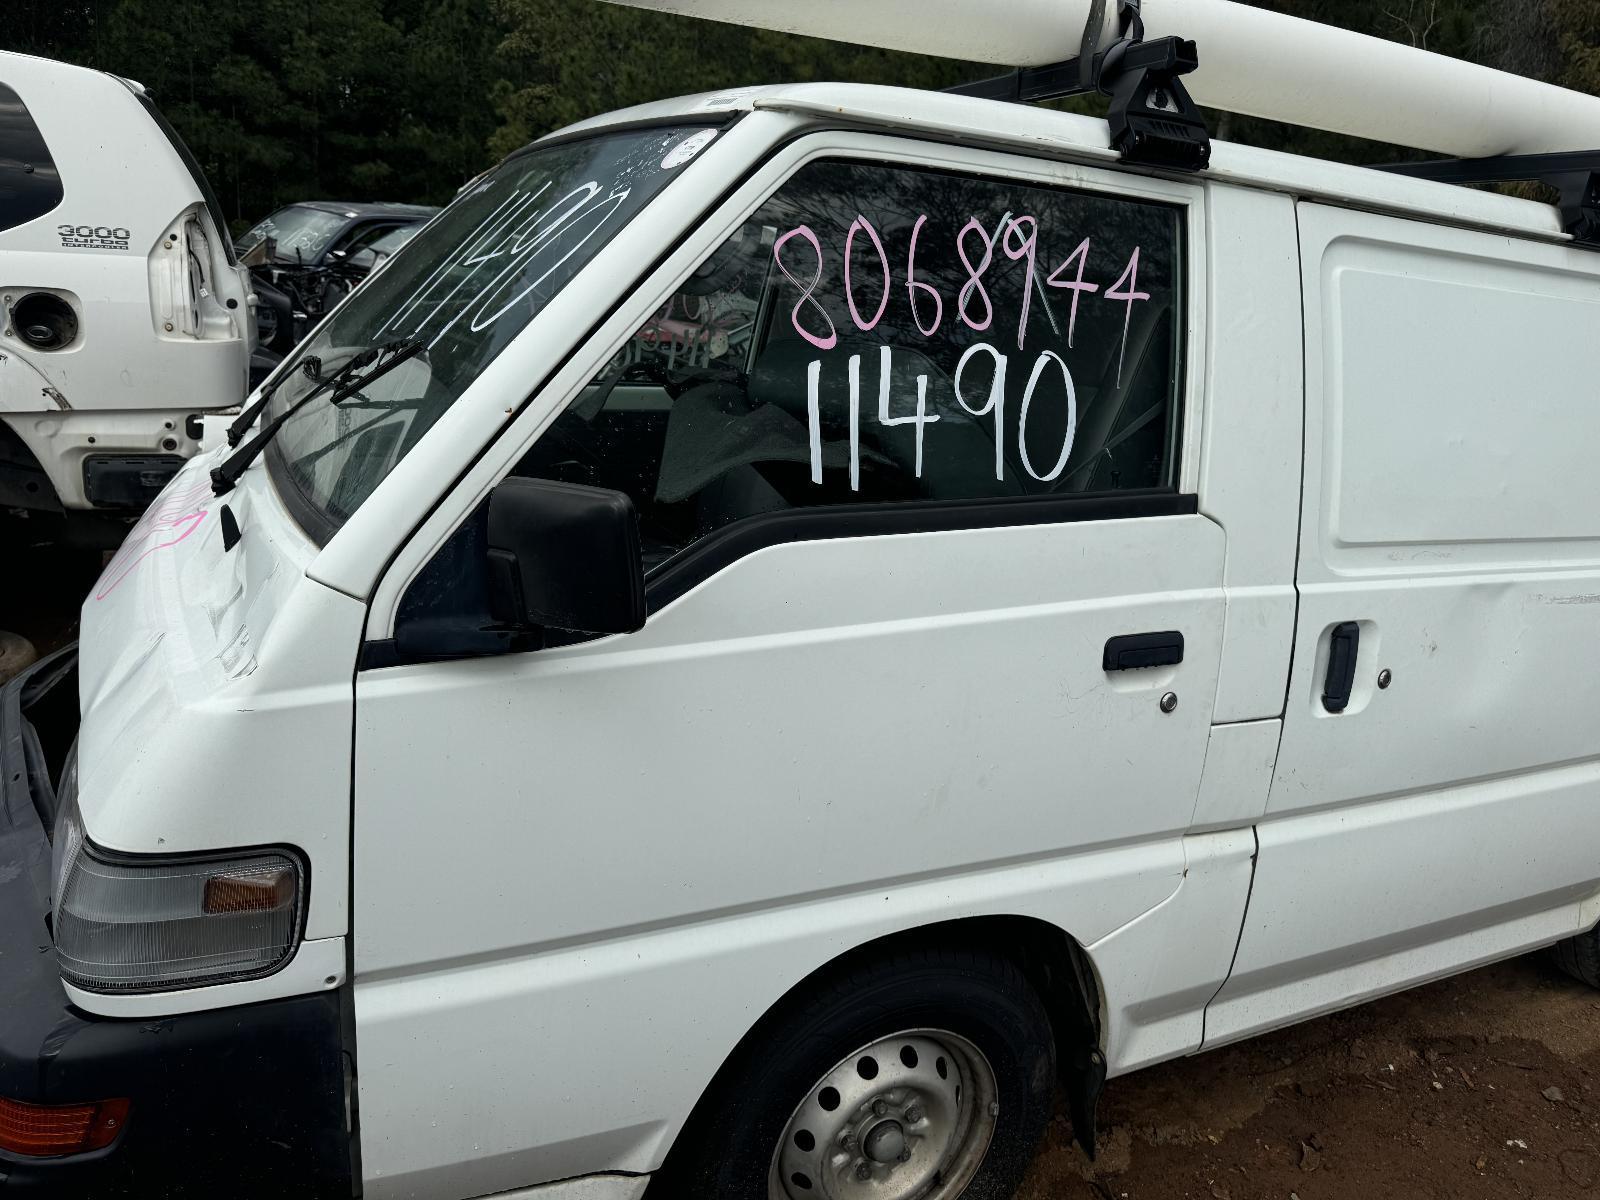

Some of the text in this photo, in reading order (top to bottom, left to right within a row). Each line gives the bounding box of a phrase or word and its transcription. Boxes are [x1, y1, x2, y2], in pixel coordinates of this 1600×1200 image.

[57, 224, 131, 240] 3000
[773, 214, 1150, 389] 8068944
[807, 343, 1077, 491] 11490
